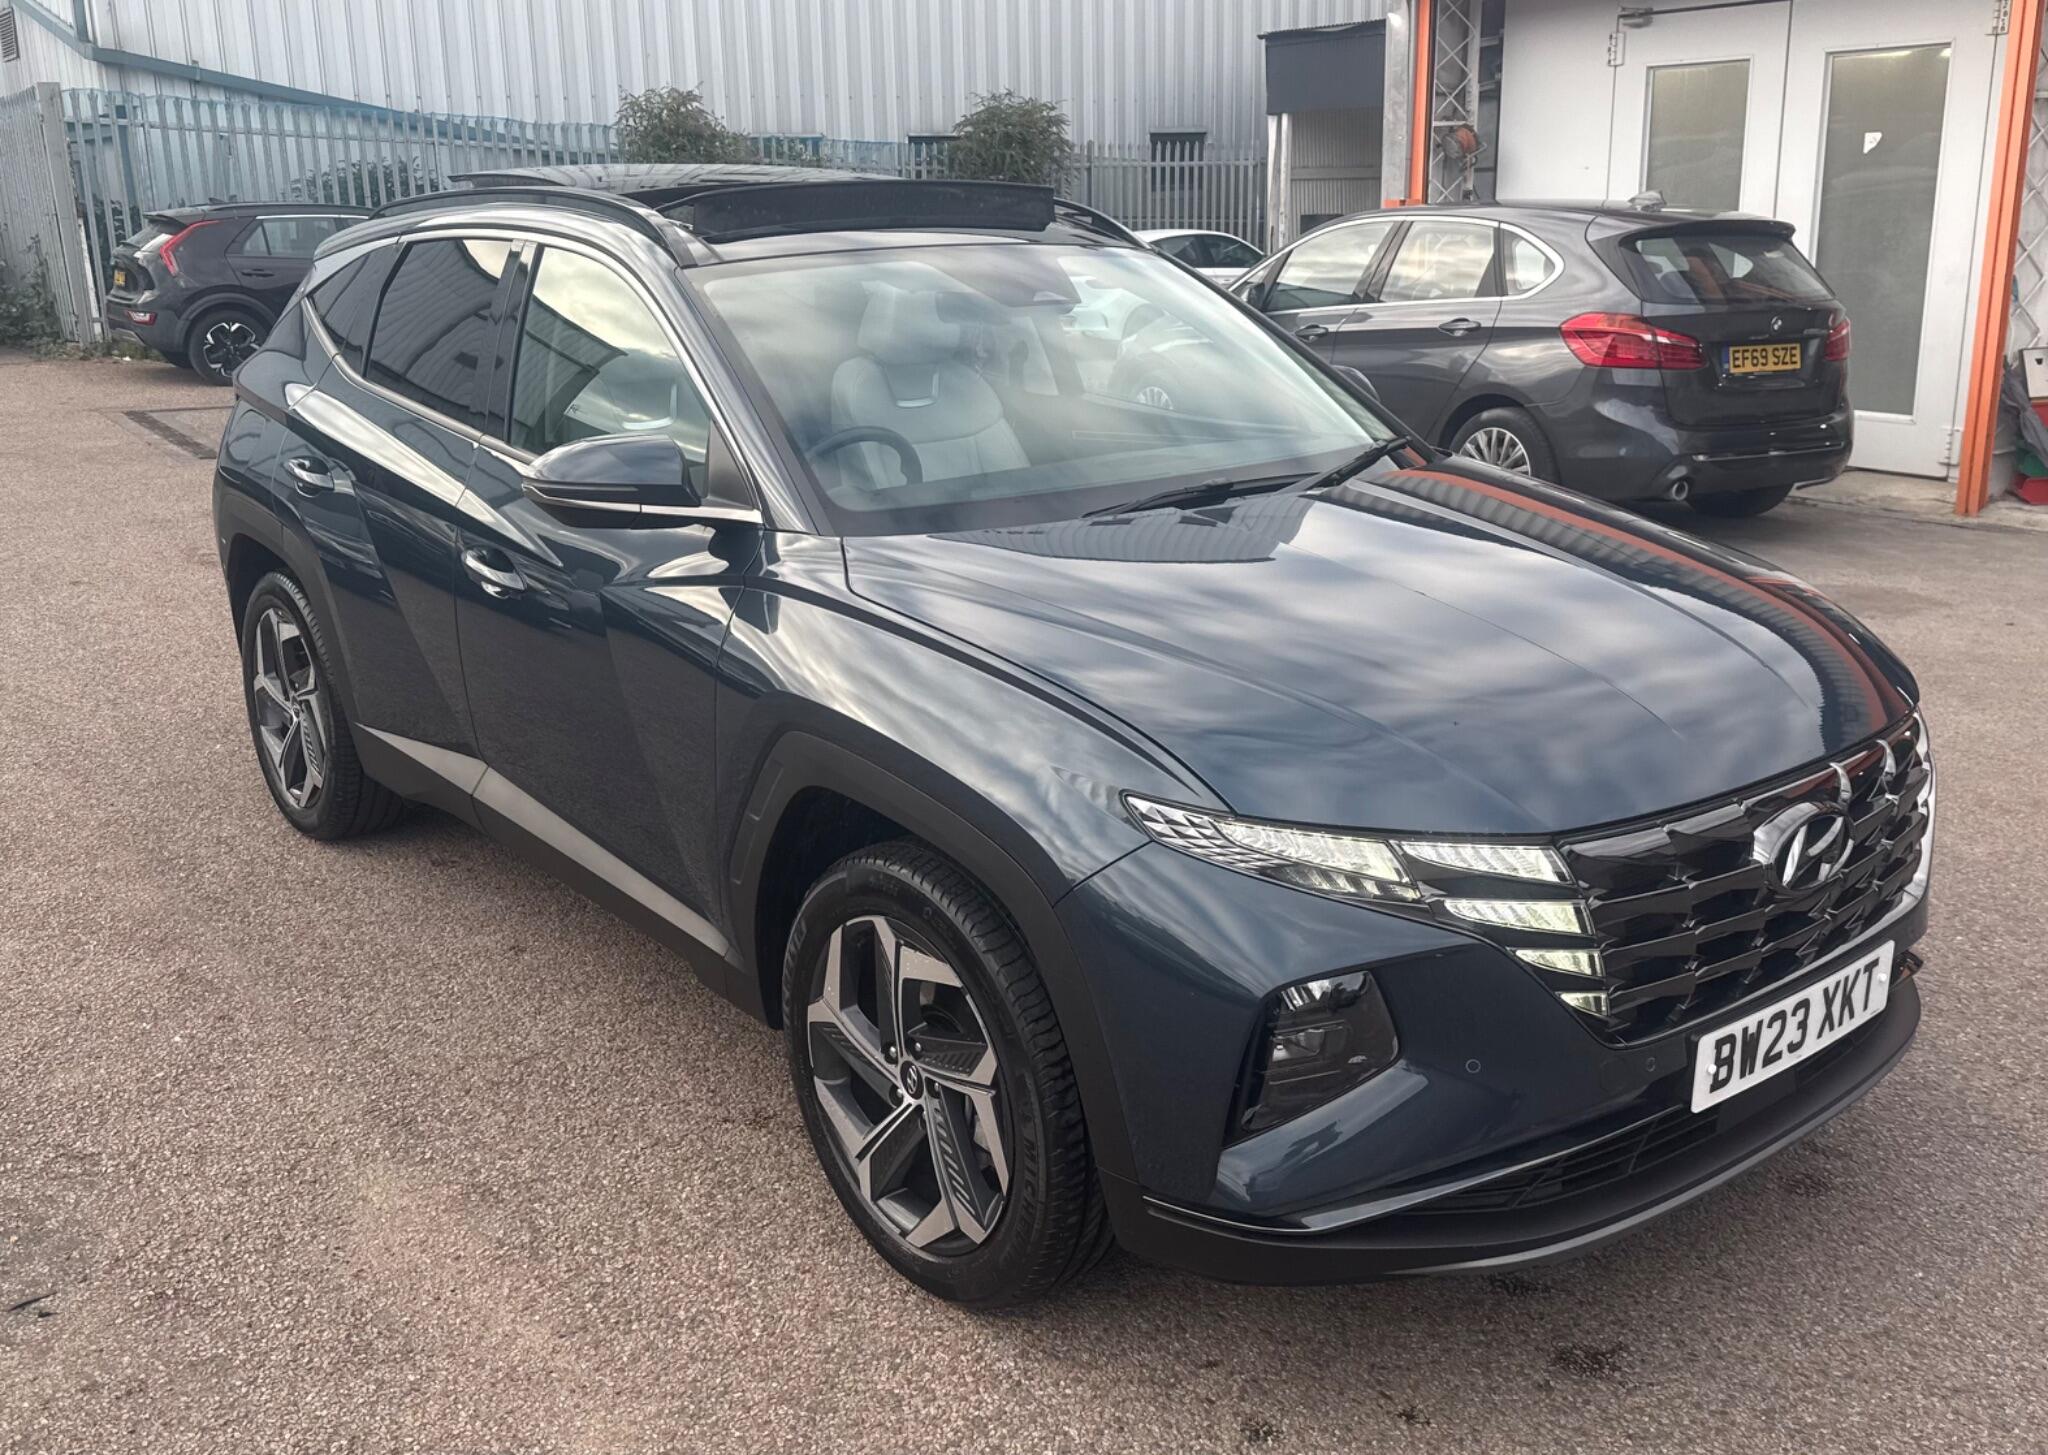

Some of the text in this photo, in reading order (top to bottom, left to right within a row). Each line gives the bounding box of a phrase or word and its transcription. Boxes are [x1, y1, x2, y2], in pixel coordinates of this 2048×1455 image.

[1732, 346, 1797, 368] EF69 SZE
[1709, 957, 1880, 1093] BW23 XKT
